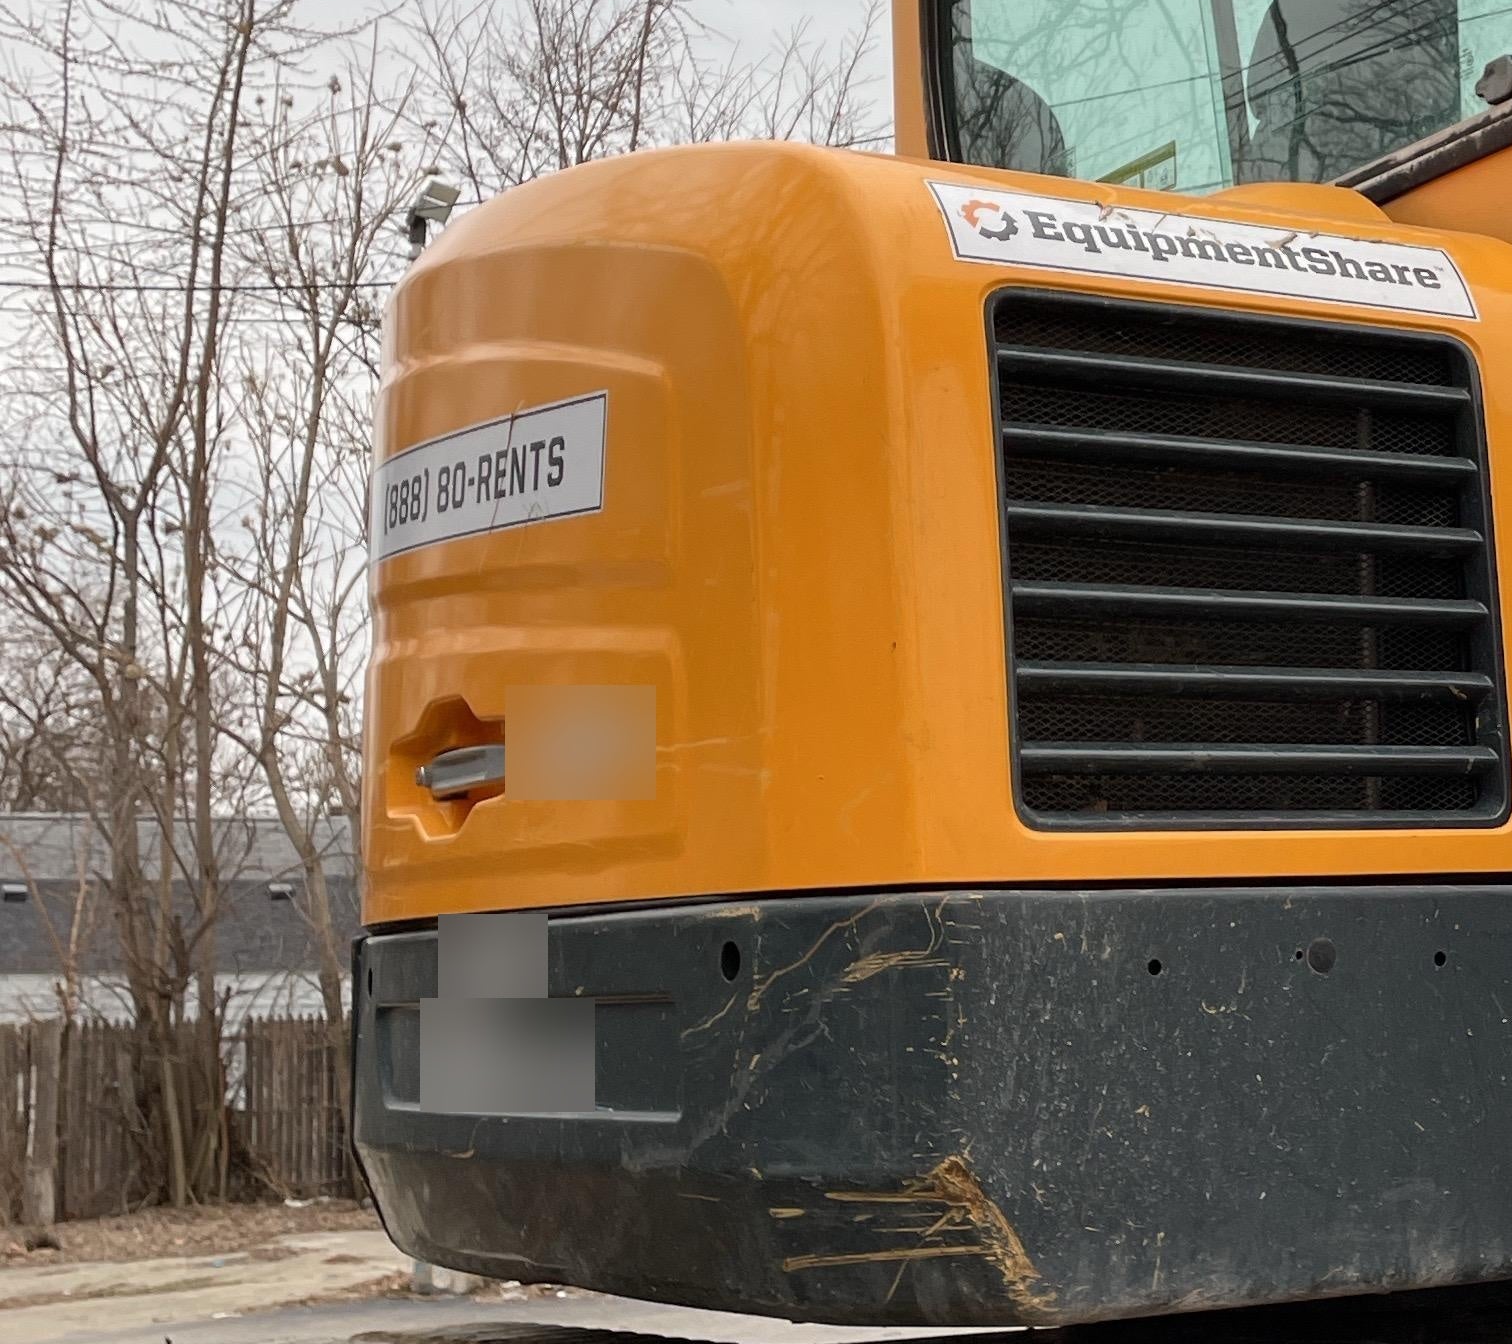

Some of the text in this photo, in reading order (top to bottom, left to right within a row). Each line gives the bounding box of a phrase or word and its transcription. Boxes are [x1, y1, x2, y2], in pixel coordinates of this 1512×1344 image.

[1022, 208, 1443, 291] EquipmentShare
[383, 435, 566, 536] (888) 80-RENTS
